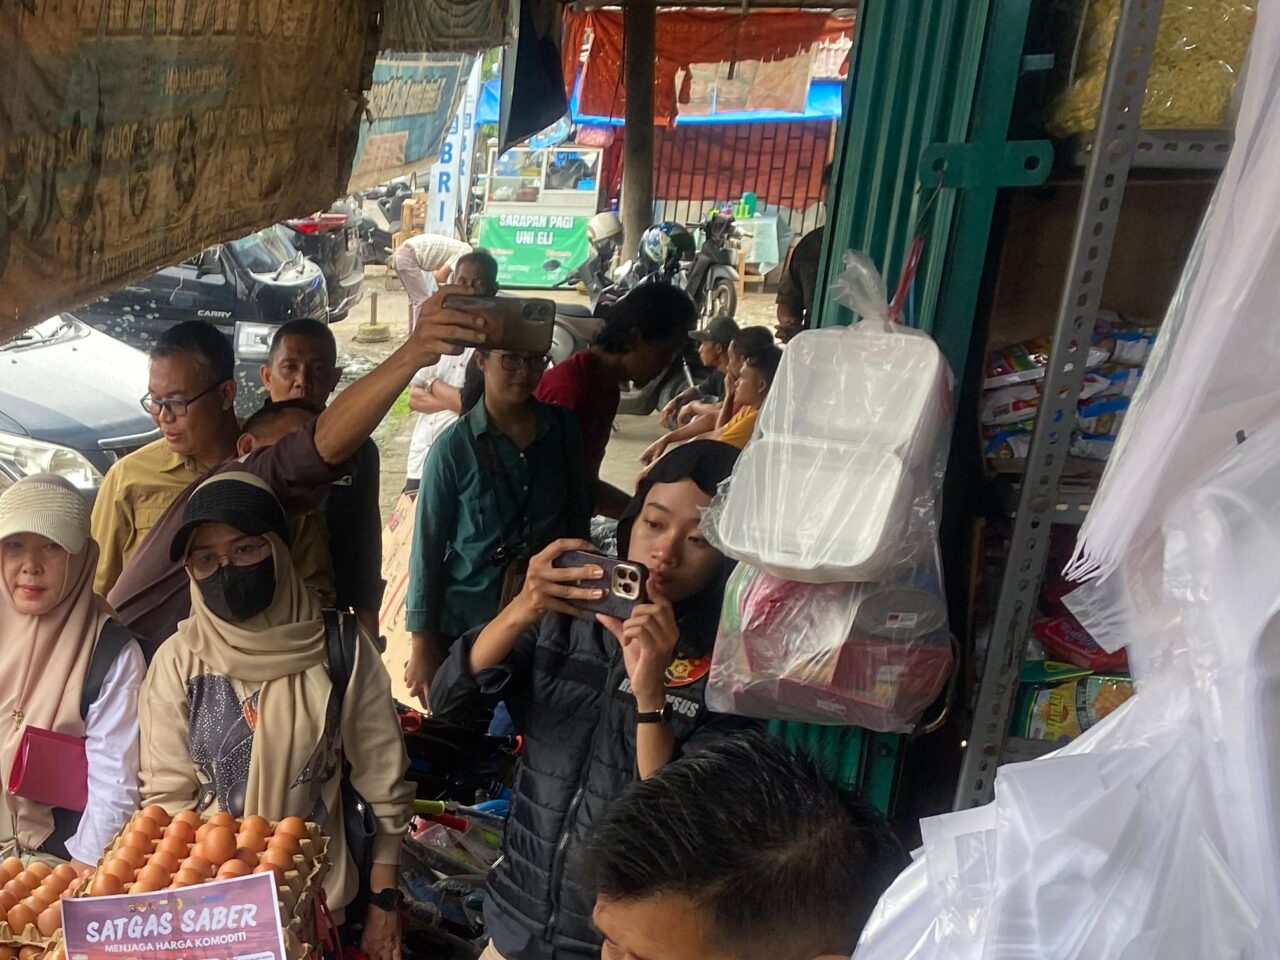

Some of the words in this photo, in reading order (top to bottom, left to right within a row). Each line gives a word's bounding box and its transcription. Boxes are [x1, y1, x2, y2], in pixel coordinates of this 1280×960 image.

[499, 215, 547, 228] SARAPAN
[549, 216, 574, 229] PAGI
[515, 230, 535, 245] UNI
[536, 231, 554, 245] ELI
[197, 309, 232, 319] CARRY
[86, 912, 173, 943] SATGAS
[180, 904, 257, 933] SABER
[105, 942, 154, 953] MENJAGA
[156, 938, 194, 950] HARGA
